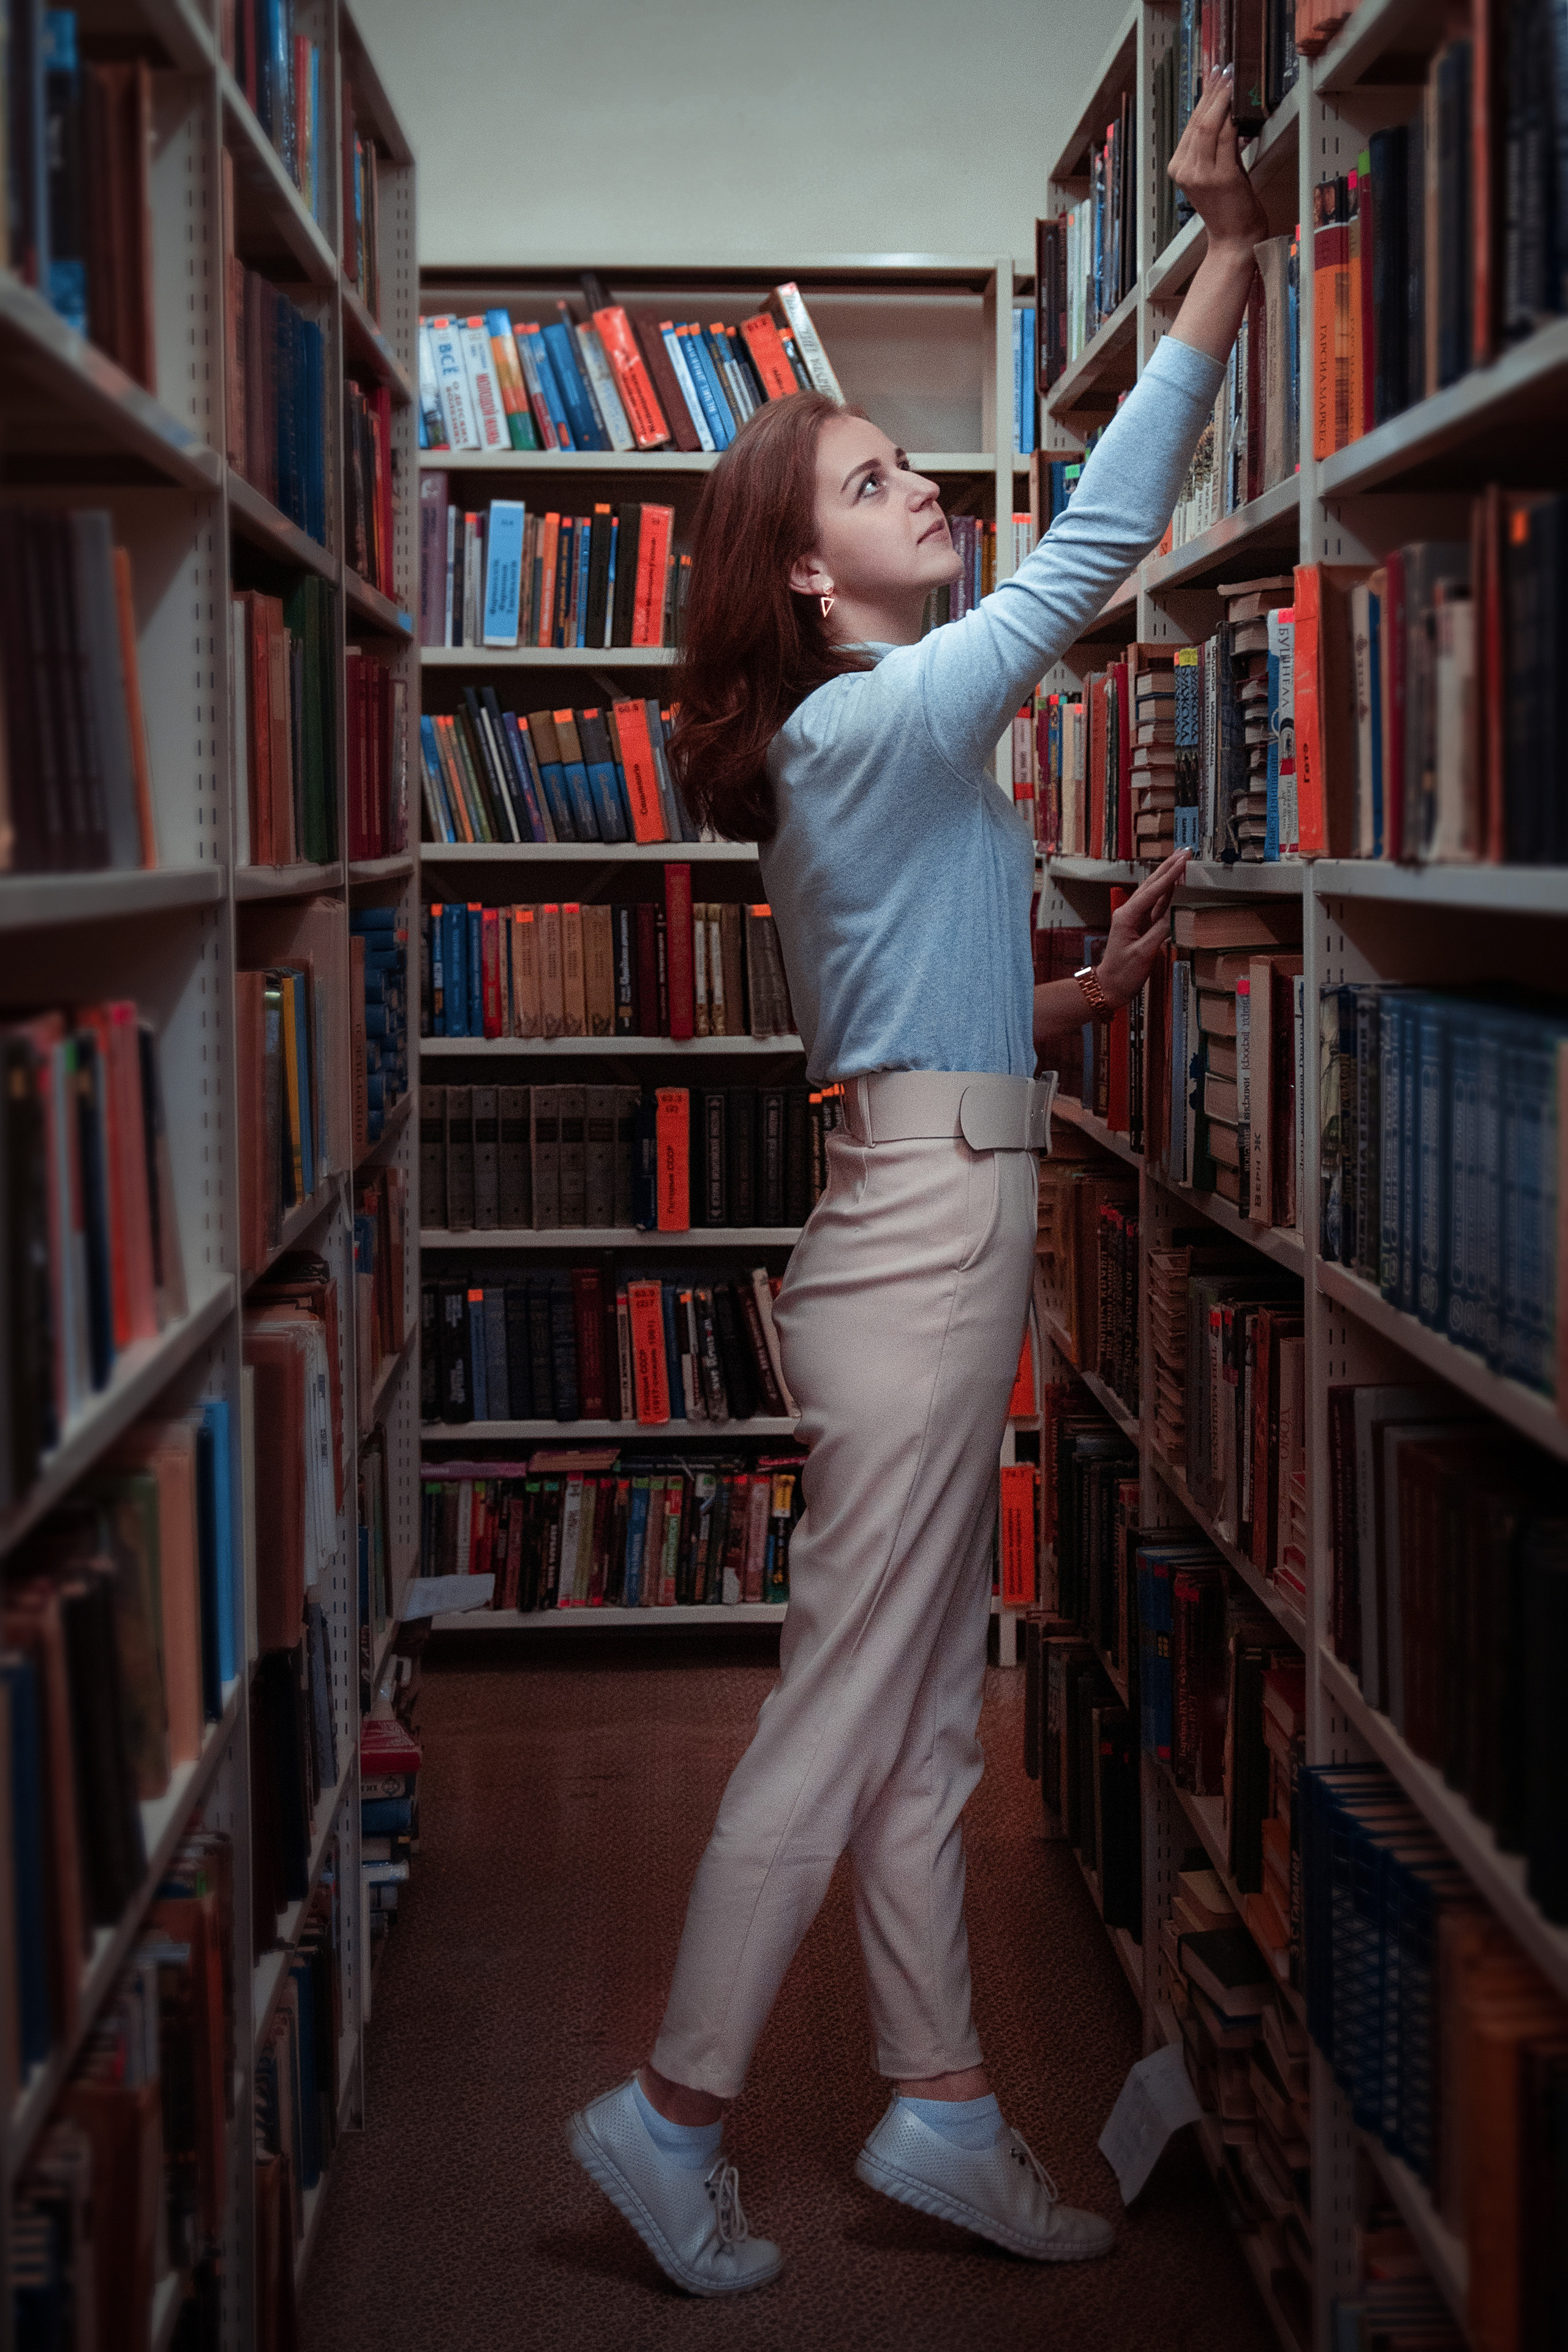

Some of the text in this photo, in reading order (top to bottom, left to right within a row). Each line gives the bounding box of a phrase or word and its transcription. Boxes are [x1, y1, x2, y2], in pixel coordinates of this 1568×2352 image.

[1319, 325, 1327, 383] ГАРСИА
[1254, 1133, 1261, 1153] Ж
[638, 1349, 649, 1374] СССР
